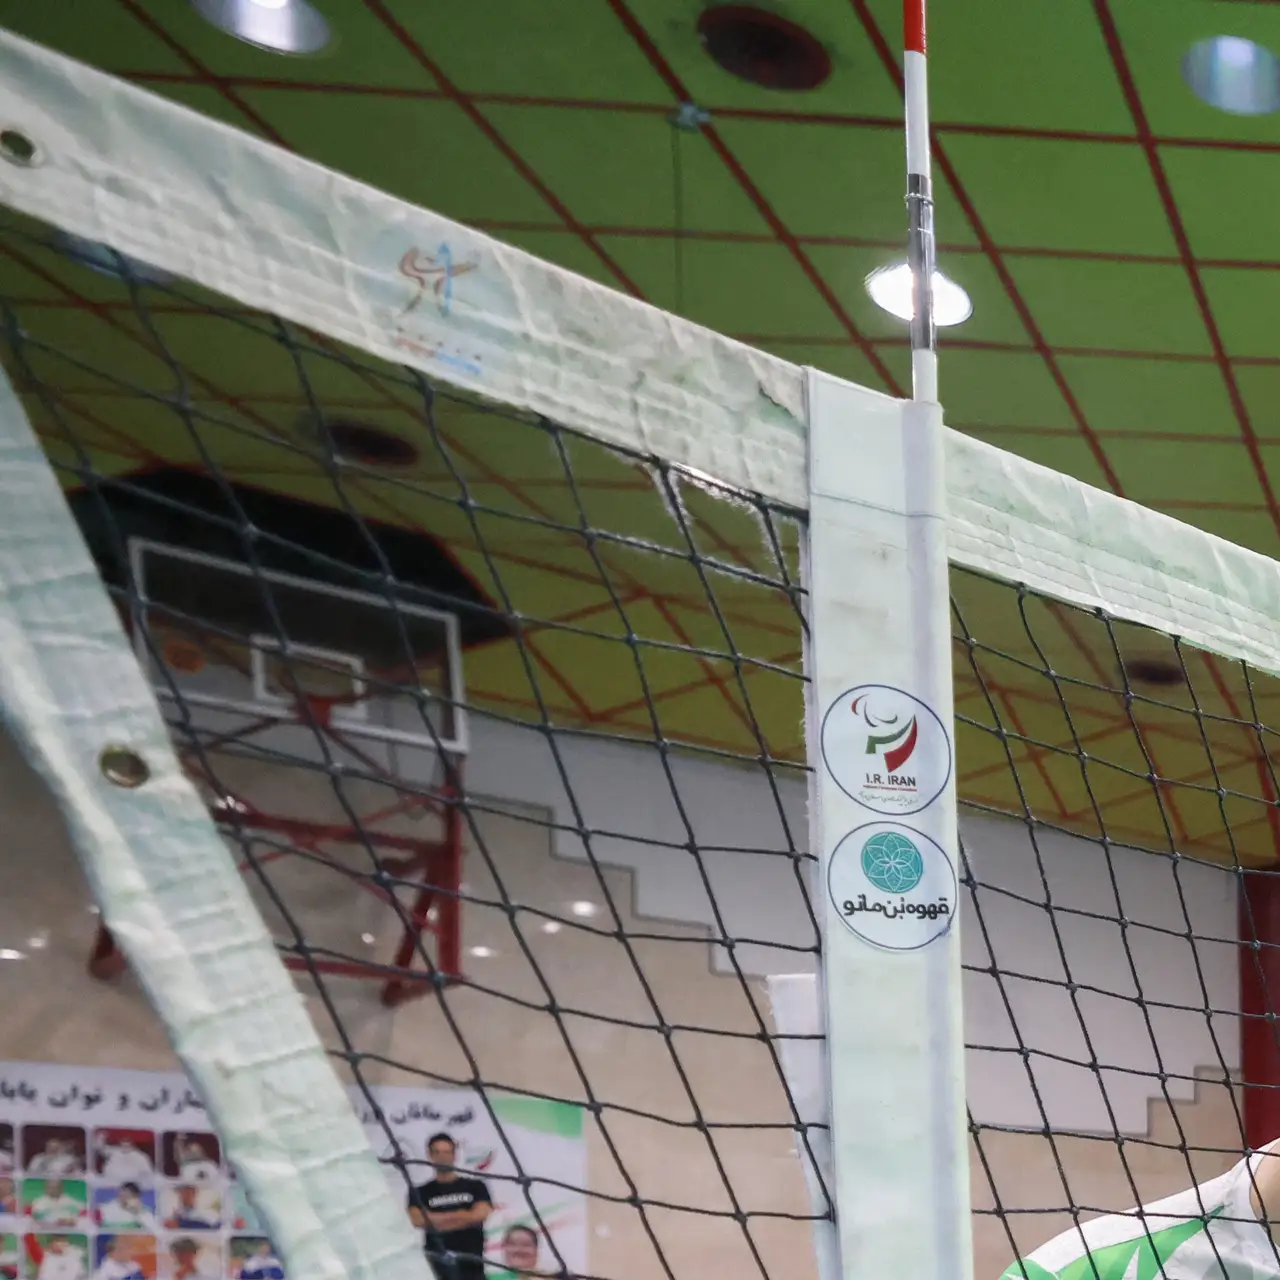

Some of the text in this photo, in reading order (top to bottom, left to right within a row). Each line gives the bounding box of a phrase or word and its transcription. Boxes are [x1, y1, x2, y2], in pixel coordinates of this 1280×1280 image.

[865, 772, 917, 787] I.R. IRAN
[842, 893, 883, 917] مانو
[906, 896, 950, 920] قهوه
